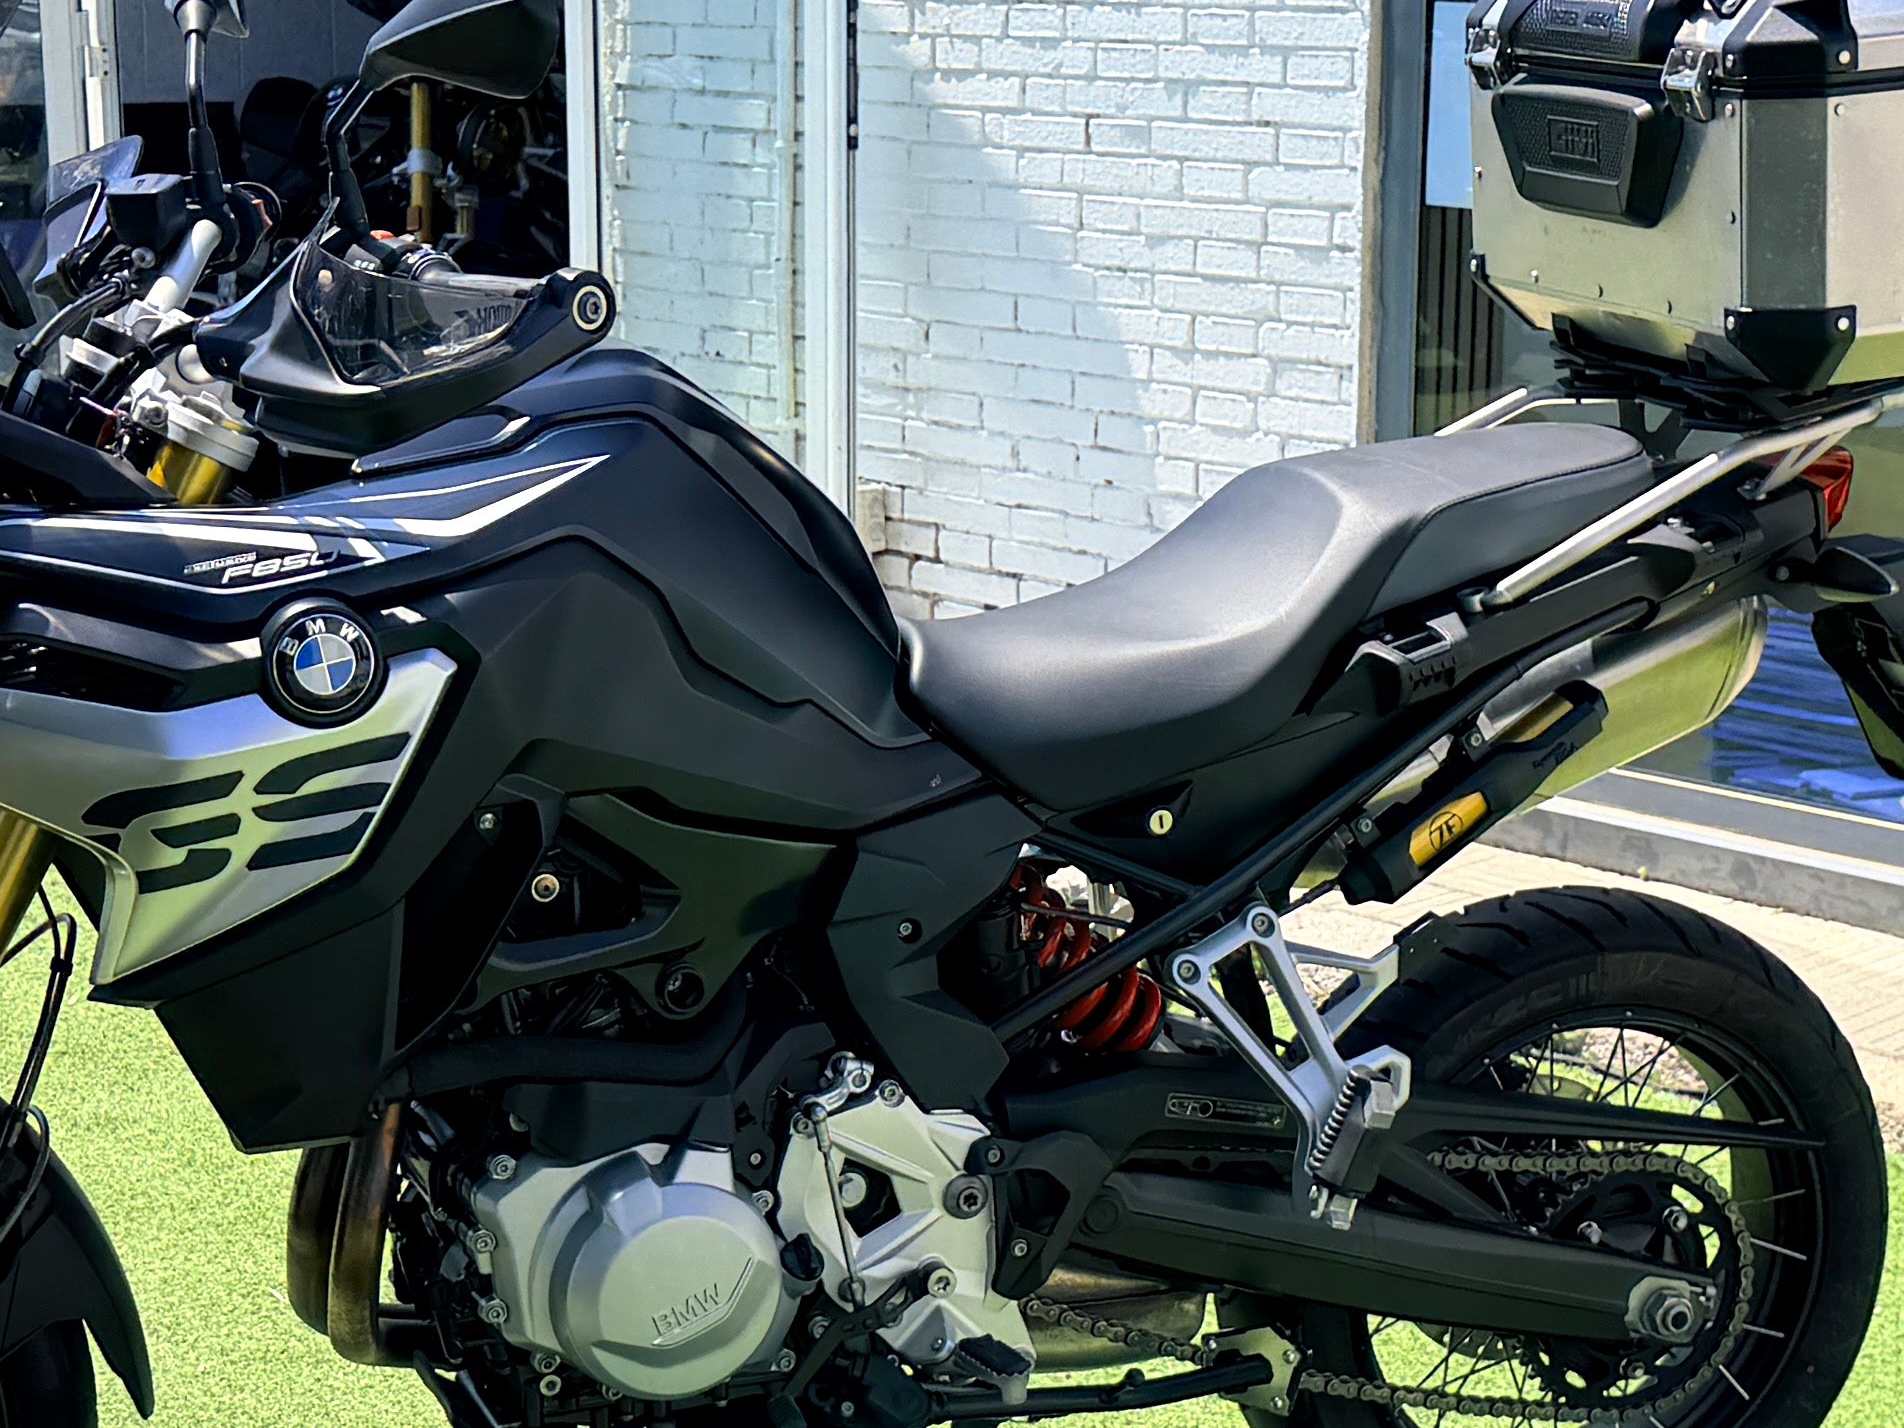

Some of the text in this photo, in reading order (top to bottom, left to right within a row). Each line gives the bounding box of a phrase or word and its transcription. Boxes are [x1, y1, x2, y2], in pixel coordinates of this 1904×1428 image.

[278, 617, 360, 657] BMW
[80, 730, 413, 894] GS
[651, 1282, 719, 1336] BMW
